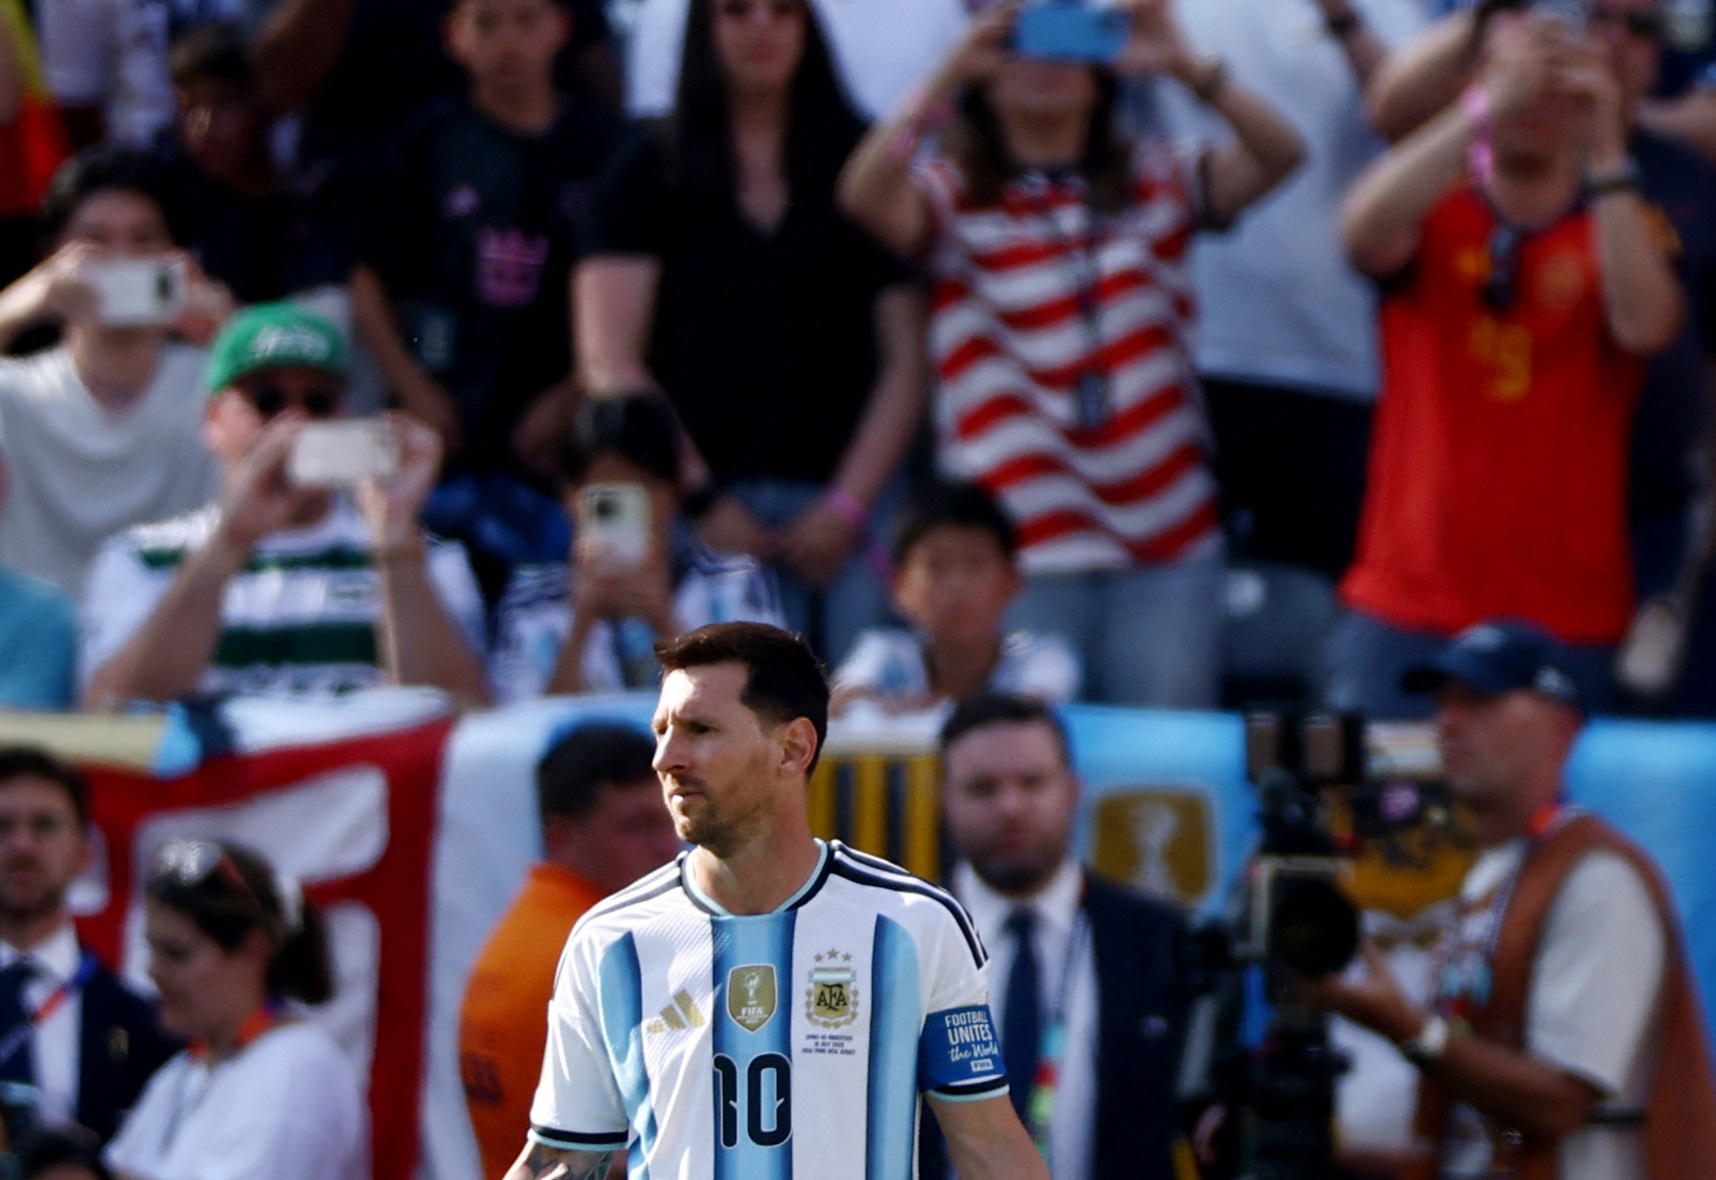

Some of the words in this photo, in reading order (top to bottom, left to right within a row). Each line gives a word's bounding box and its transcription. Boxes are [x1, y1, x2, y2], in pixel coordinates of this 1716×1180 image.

[944, 1010, 989, 1028] FOOTBALL
[947, 1023, 993, 1046] UNITES
[947, 1045, 972, 1062] the
[971, 1041, 1000, 1058] World
[713, 1052, 792, 1149] 10
